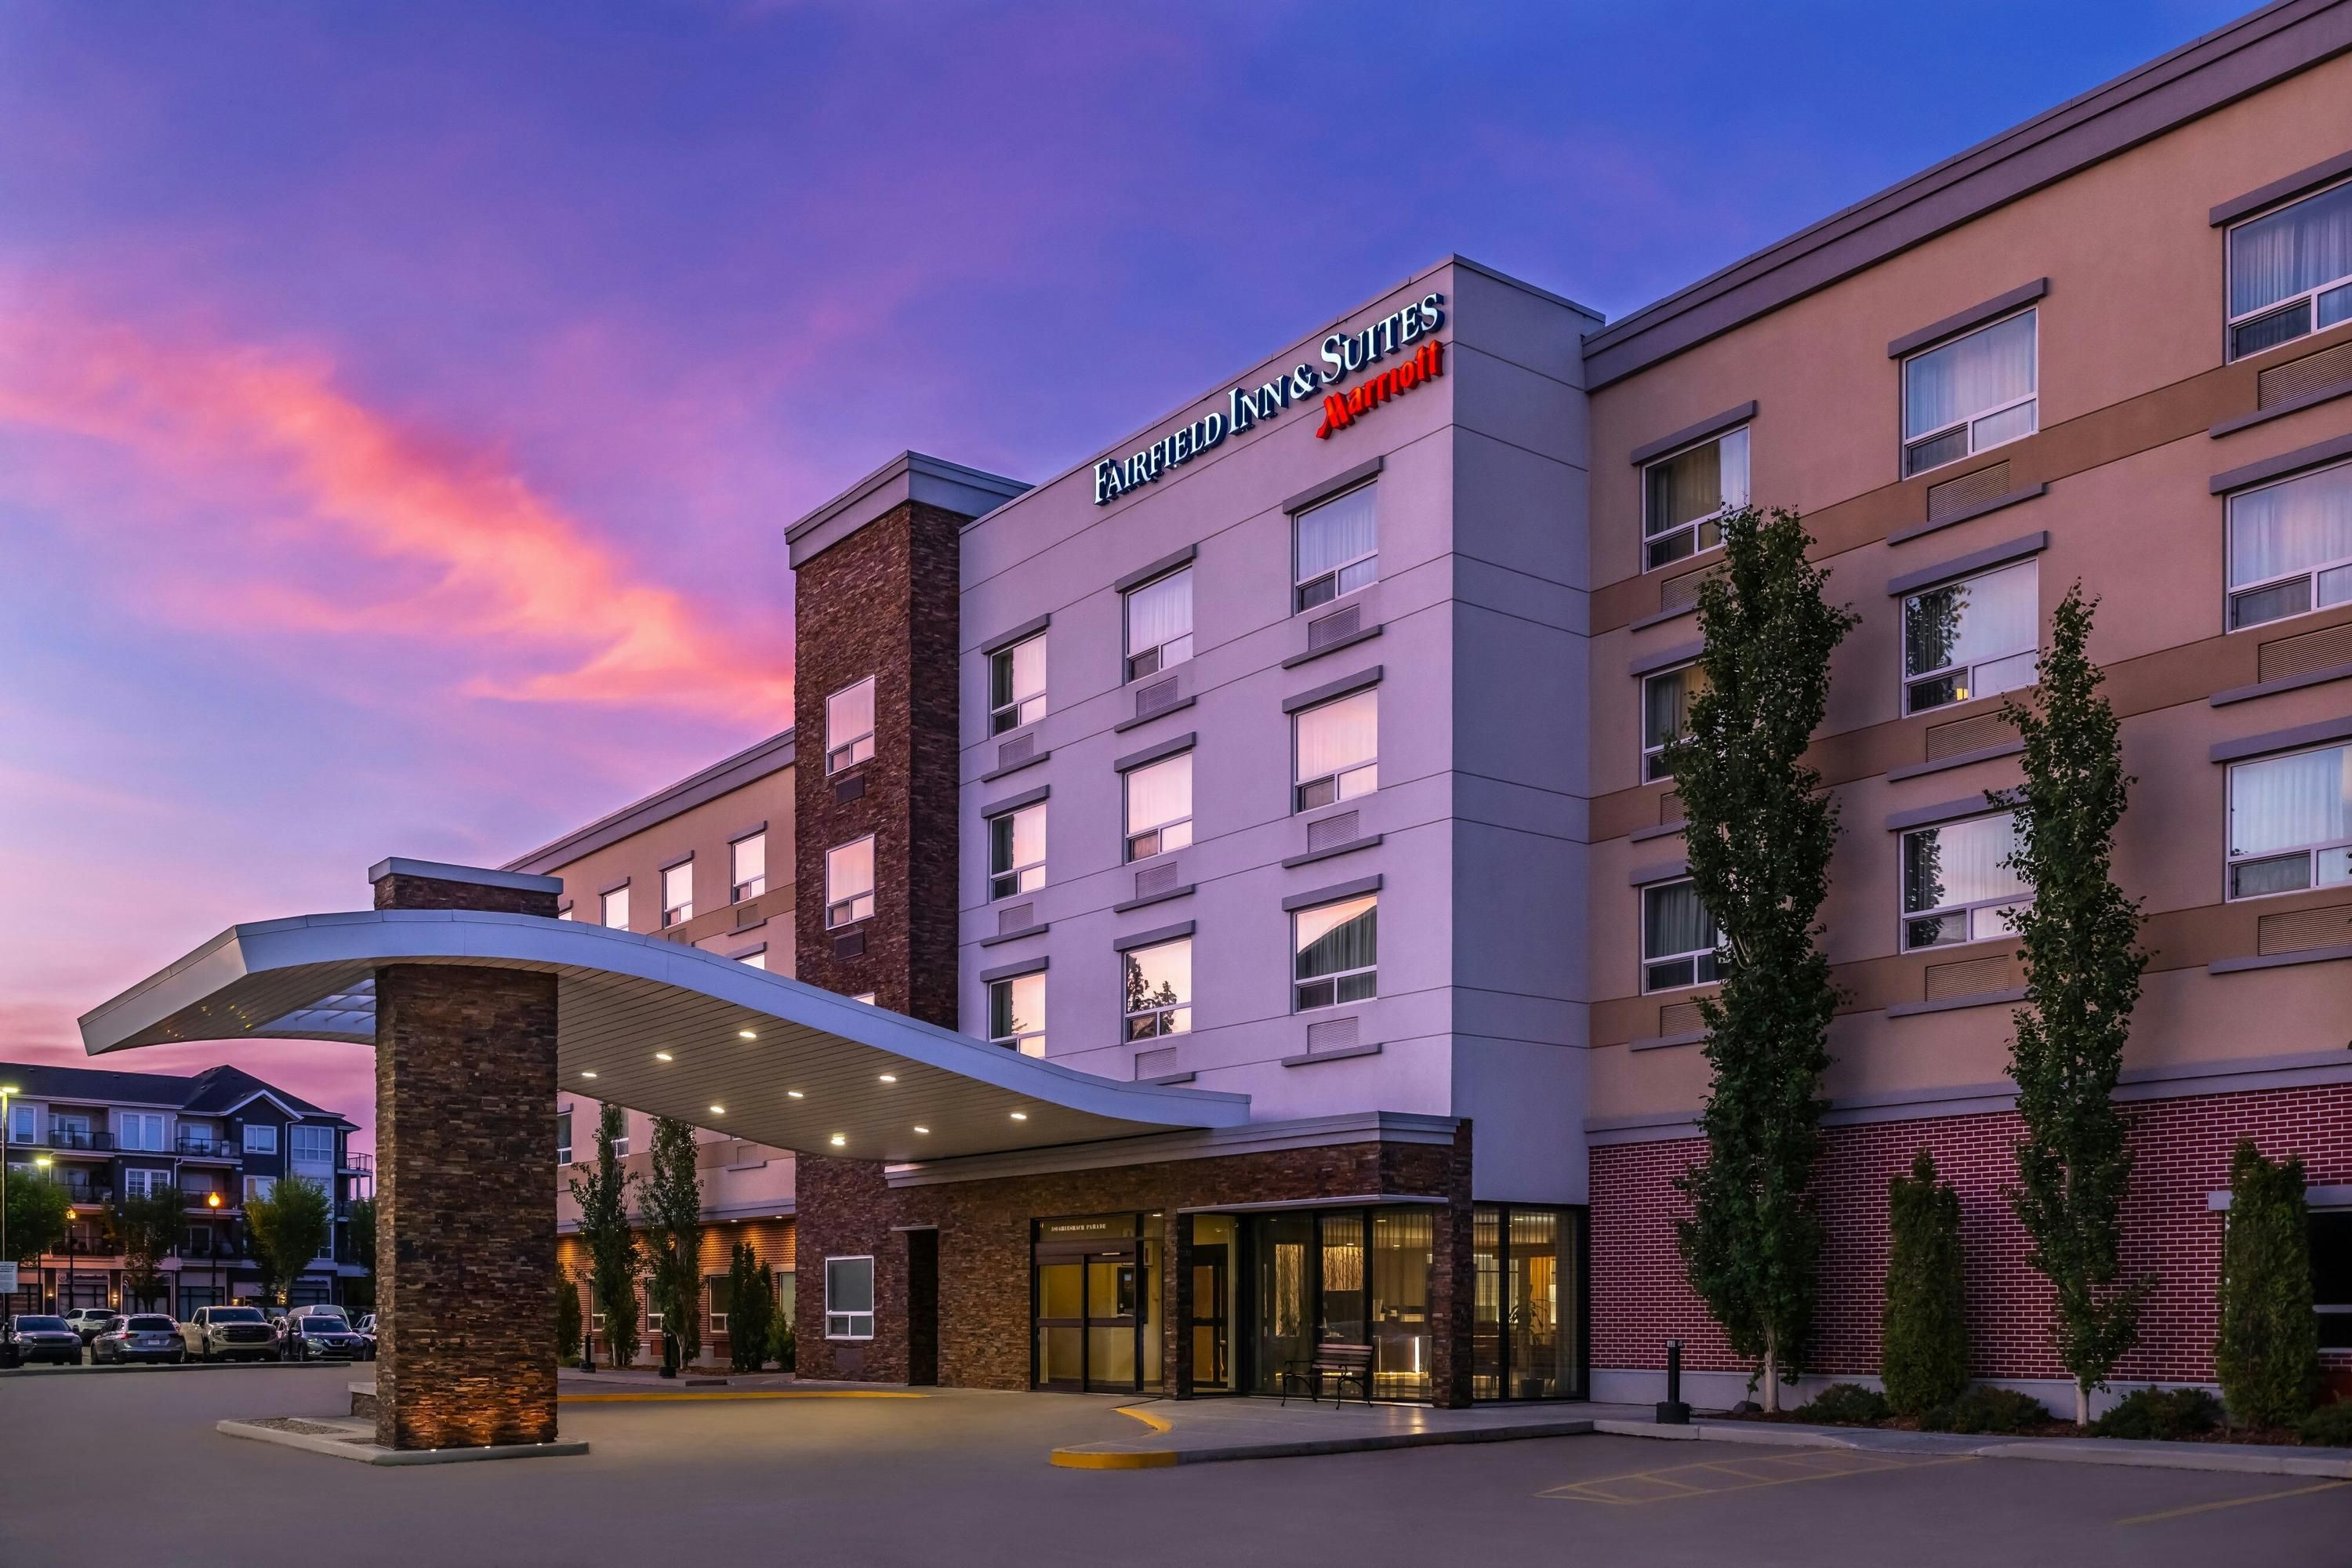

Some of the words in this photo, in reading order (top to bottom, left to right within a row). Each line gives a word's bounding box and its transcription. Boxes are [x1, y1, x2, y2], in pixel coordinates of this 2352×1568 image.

[1093, 412, 1228, 506] FAIRFIELD
[1228, 375, 1291, 435] INN
[1290, 363, 1321, 401] &
[1320, 292, 1444, 385] SUITES
[1316, 339, 1444, 440] Marriott
